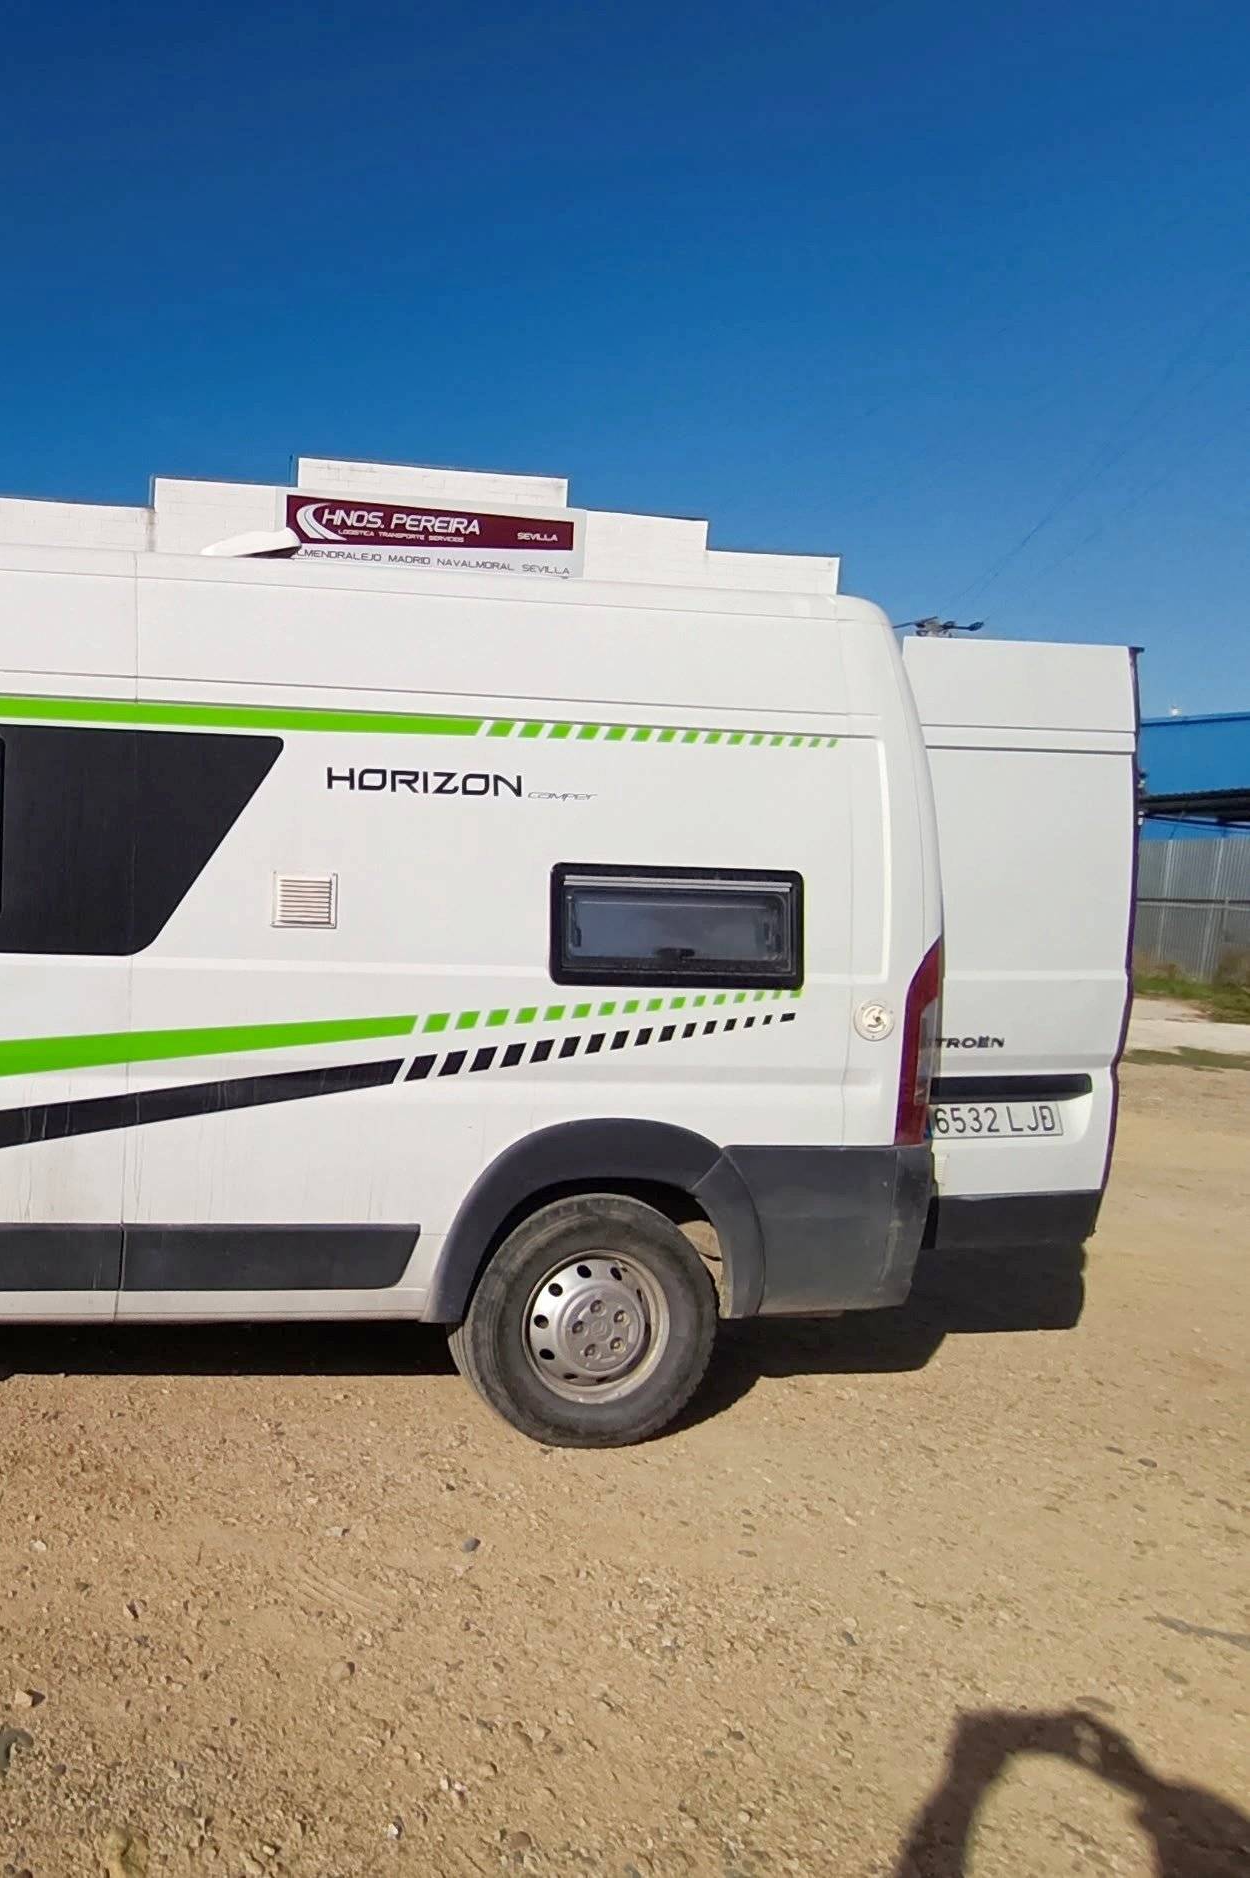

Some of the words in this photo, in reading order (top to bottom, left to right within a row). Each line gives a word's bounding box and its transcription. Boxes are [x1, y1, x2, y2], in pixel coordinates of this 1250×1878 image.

[322, 508, 385, 530] HNOS.
[390, 513, 481, 535] PEREIRA
[517, 532, 559, 543] SEVILLA
[295, 549, 382, 562] LMENDRALEJO
[388, 554, 431, 565] MADRID
[437, 557, 514, 571] NAVALMORAL
[522, 562, 571, 576] SEVILLA
[326, 766, 523, 798] HORIZON
[934, 1106, 1000, 1134] 6532
